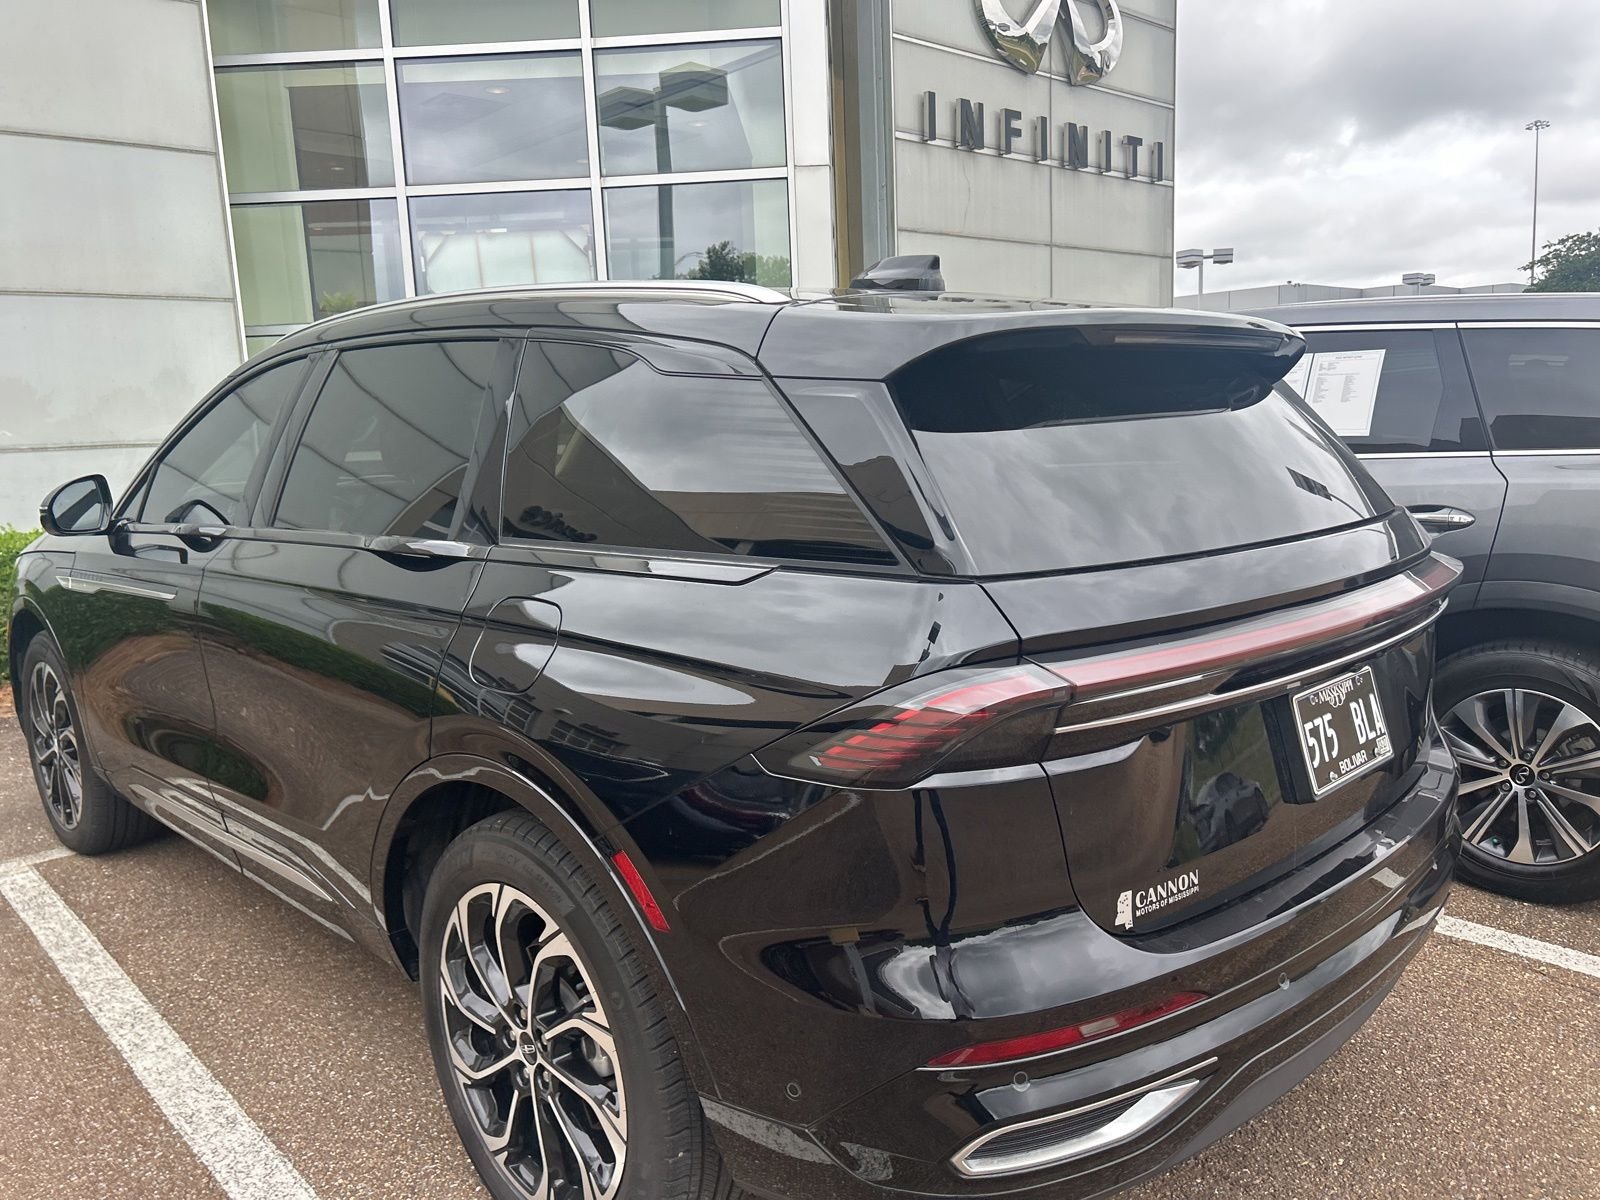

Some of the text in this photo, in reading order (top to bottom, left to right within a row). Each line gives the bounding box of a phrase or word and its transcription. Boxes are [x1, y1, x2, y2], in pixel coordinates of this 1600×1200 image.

[923, 91, 1164, 182] INFINITI
[1304, 693, 1385, 769] 575 BLA
[1338, 749, 1368, 774] BOLIVAR
[1135, 869, 1199, 908] CANNON
[1136, 885, 1200, 917] MOTORS OF MISSISSIPPI
